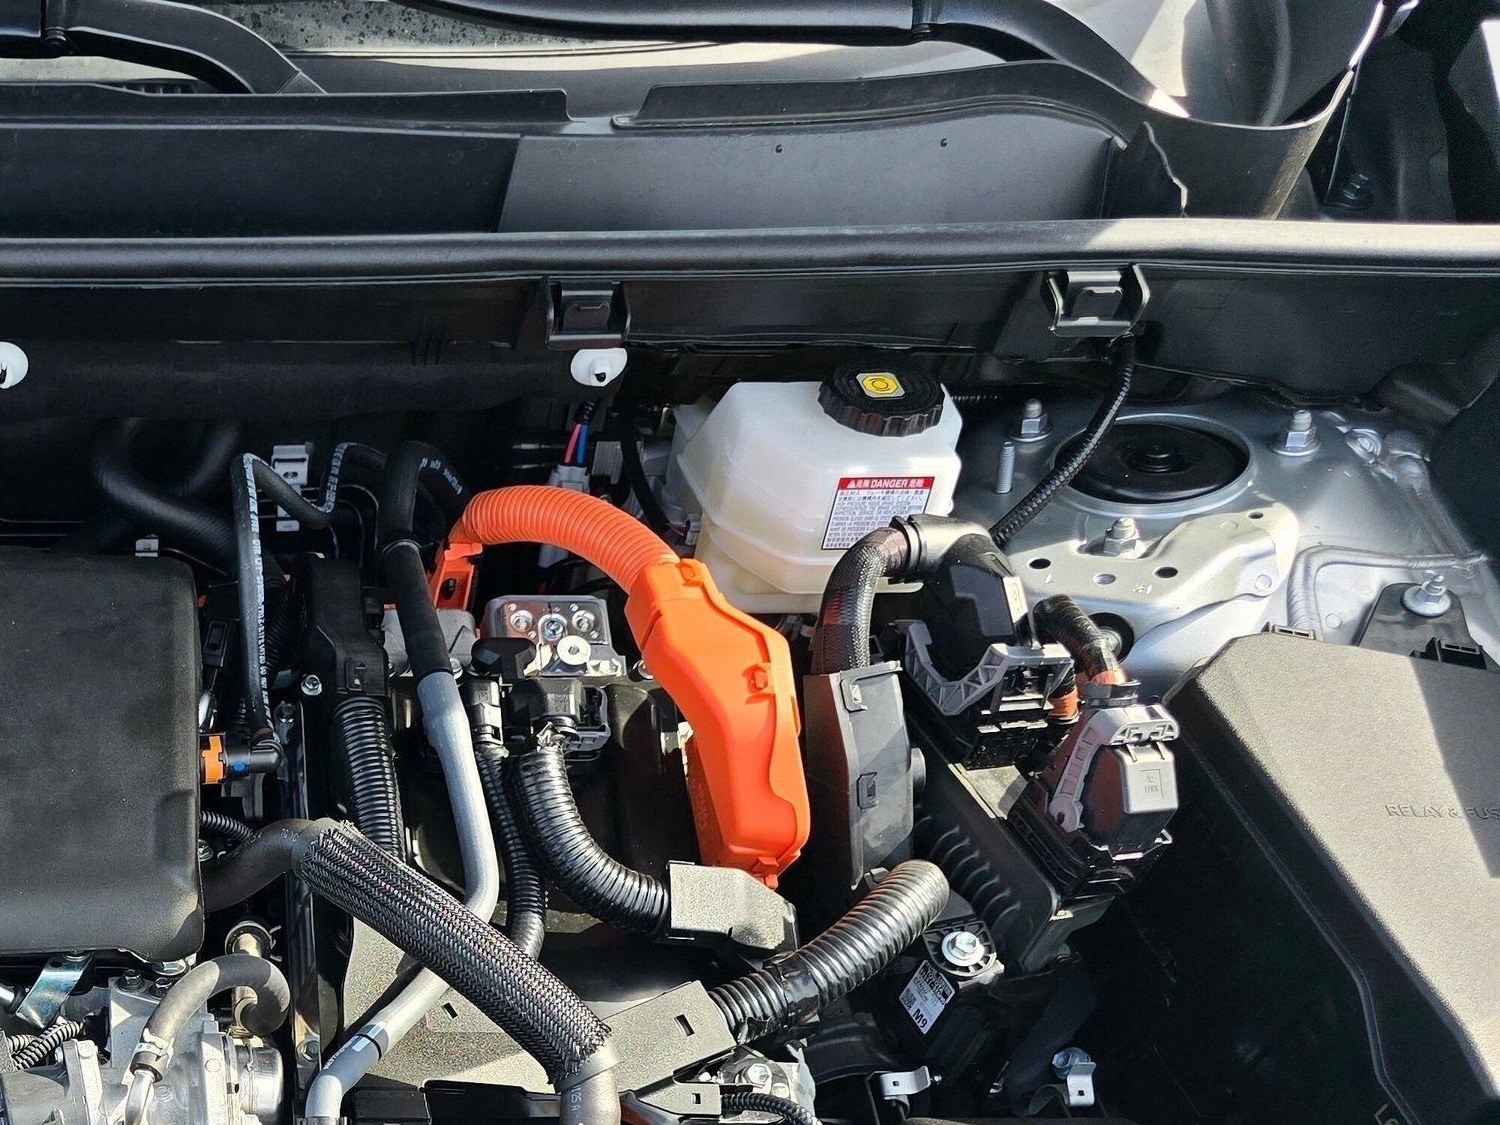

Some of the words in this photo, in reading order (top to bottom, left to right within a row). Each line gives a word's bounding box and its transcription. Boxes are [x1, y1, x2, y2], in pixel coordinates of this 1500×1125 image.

[870, 478, 908, 488] DANGER
[1384, 804, 1443, 818] RELAY
[1463, 806, 1500, 820] FUS
[912, 1008, 928, 1028] M9
